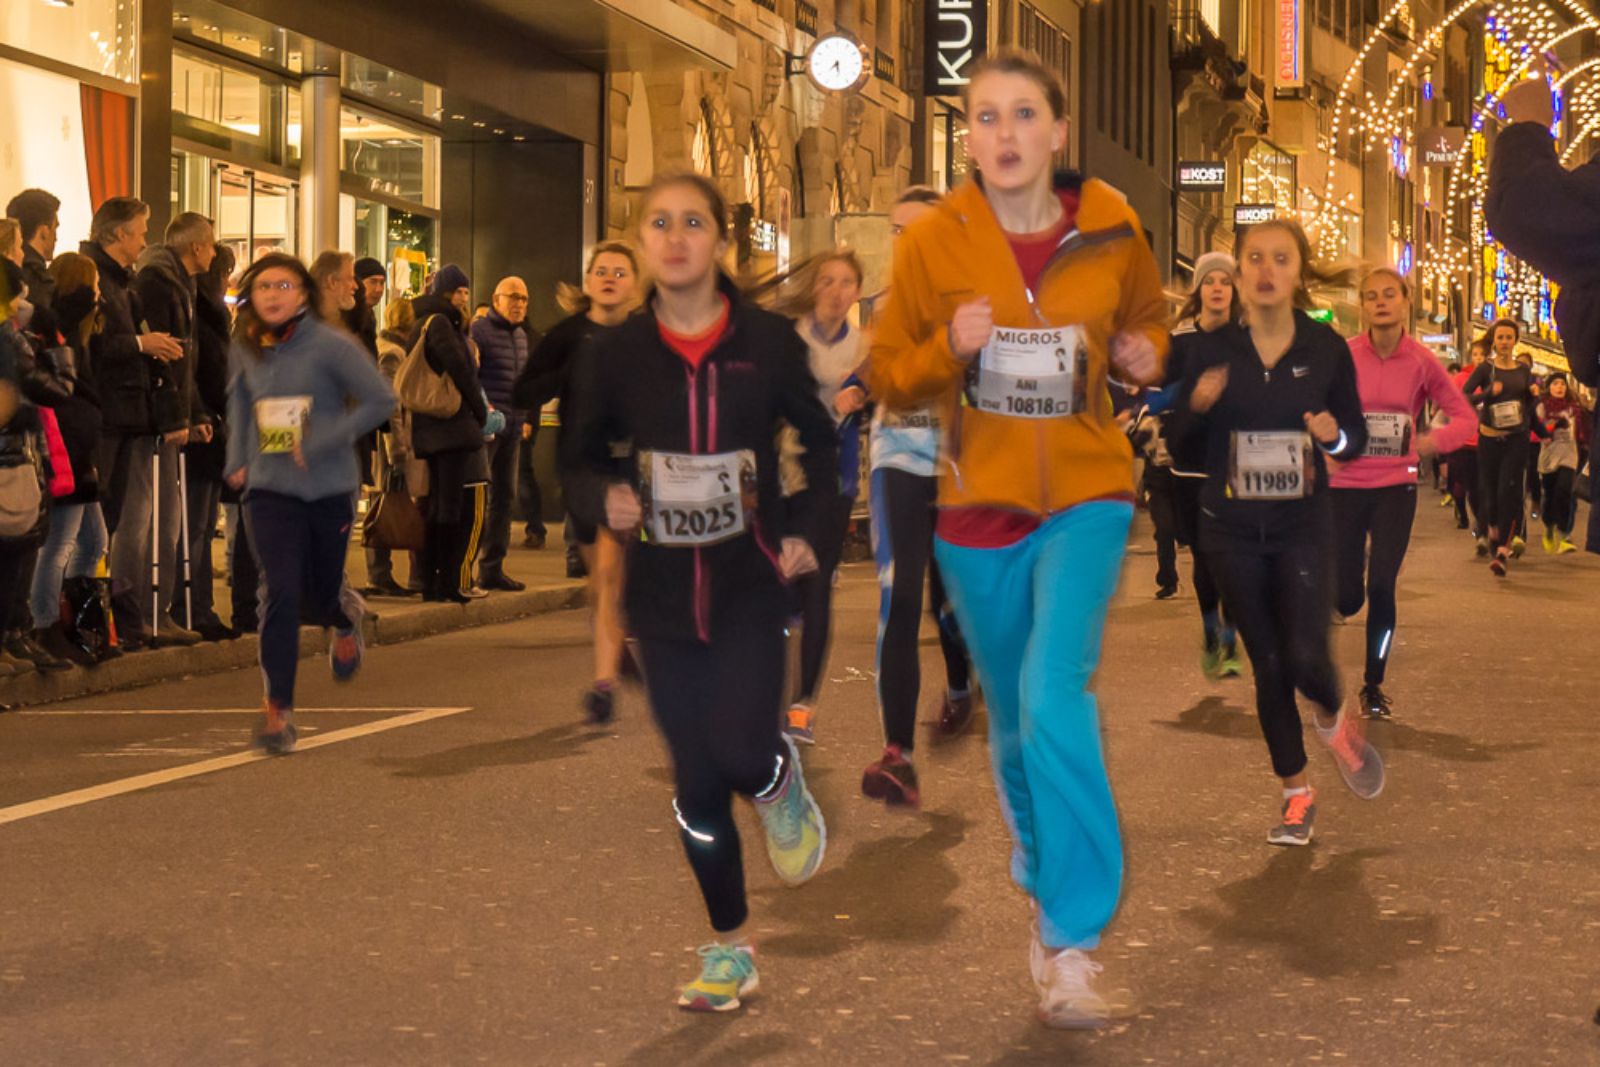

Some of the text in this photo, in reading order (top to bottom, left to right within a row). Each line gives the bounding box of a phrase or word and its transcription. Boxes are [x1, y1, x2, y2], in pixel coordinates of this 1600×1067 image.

[1191, 167, 1224, 180] KOST
[1245, 210, 1275, 221] KOST
[996, 331, 1062, 344] MIGROS
[1006, 396, 1053, 414] 10818
[1243, 471, 1299, 492] 11989
[658, 502, 737, 536] 12025
